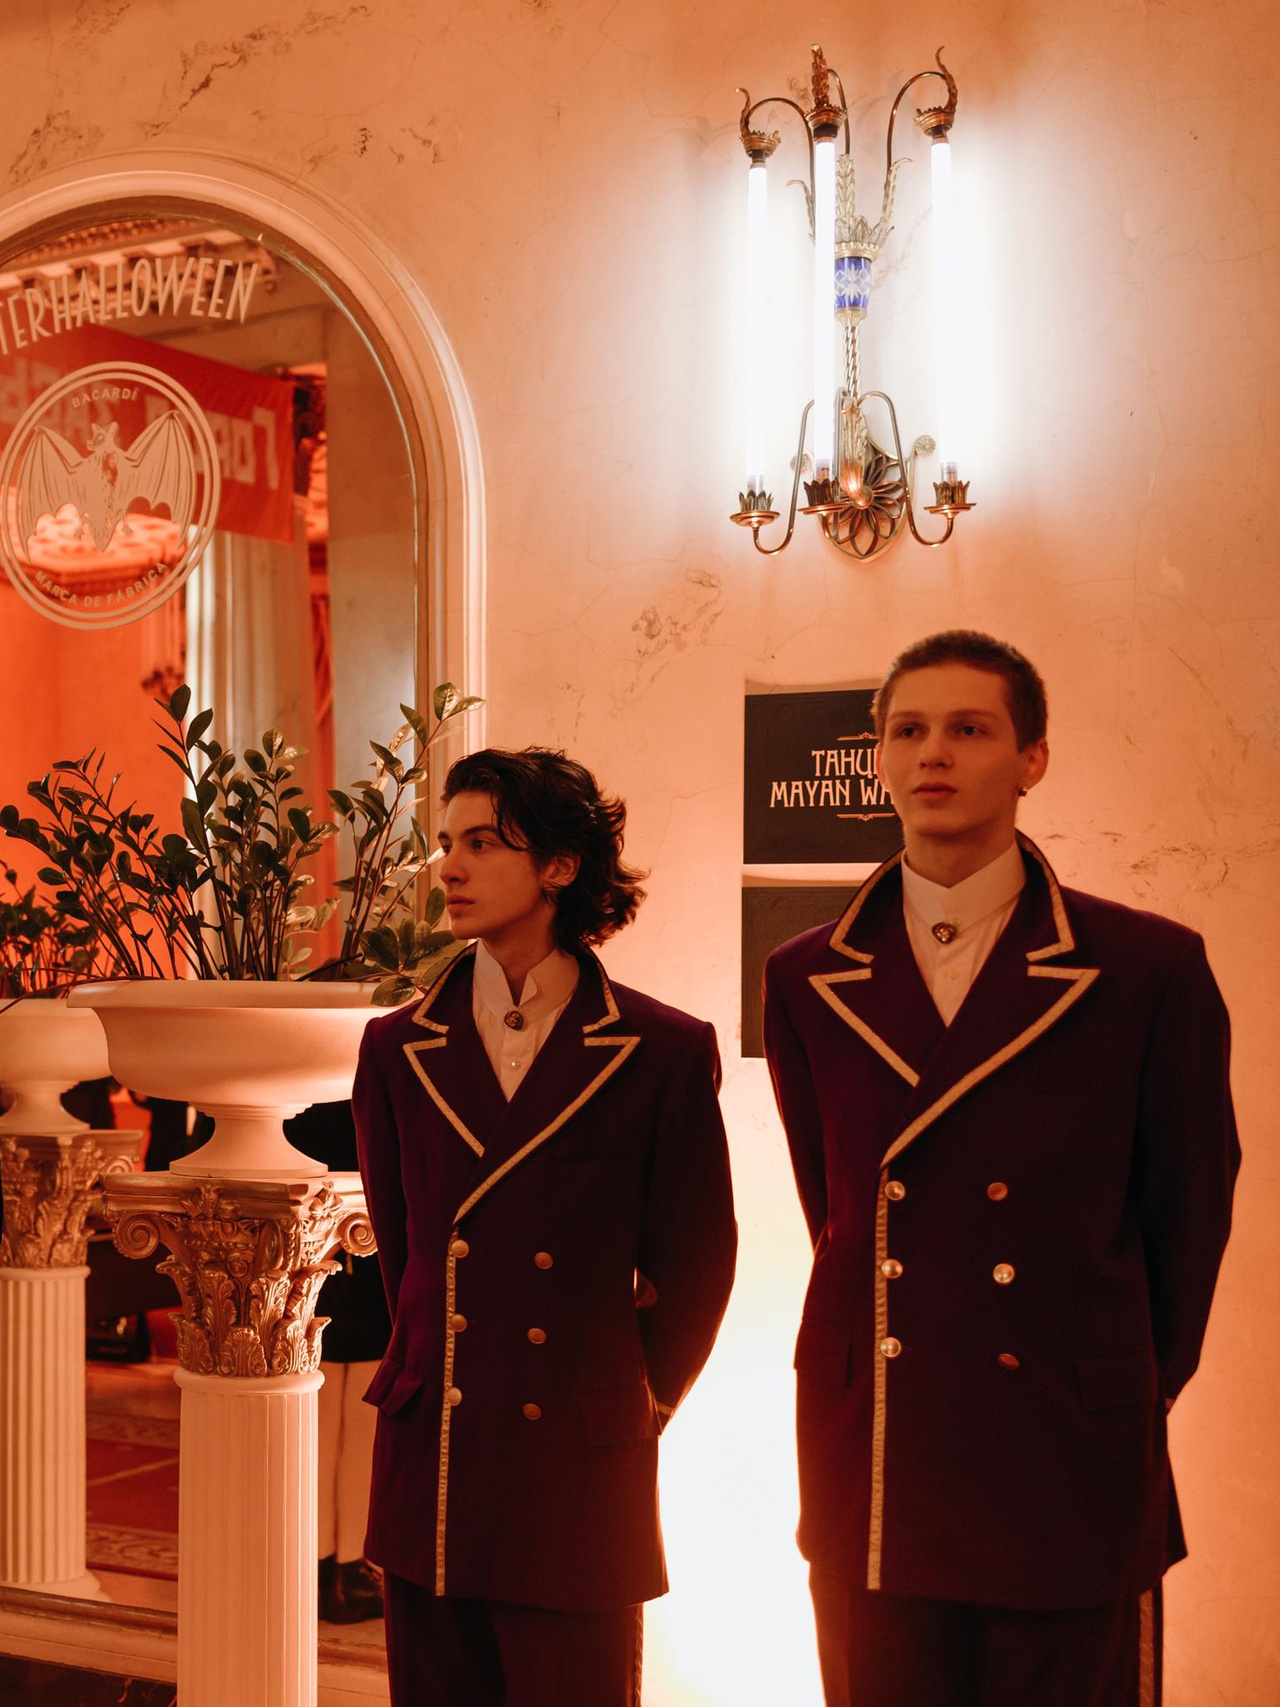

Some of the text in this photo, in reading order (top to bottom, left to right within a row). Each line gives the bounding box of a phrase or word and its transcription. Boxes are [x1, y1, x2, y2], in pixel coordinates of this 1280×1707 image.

[35, 569, 77, 605] MARCA
[84, 596, 101, 607] DE
[811, 748, 877, 779] ТАНЦ
[769, 778, 896, 808] MAYAN WA
